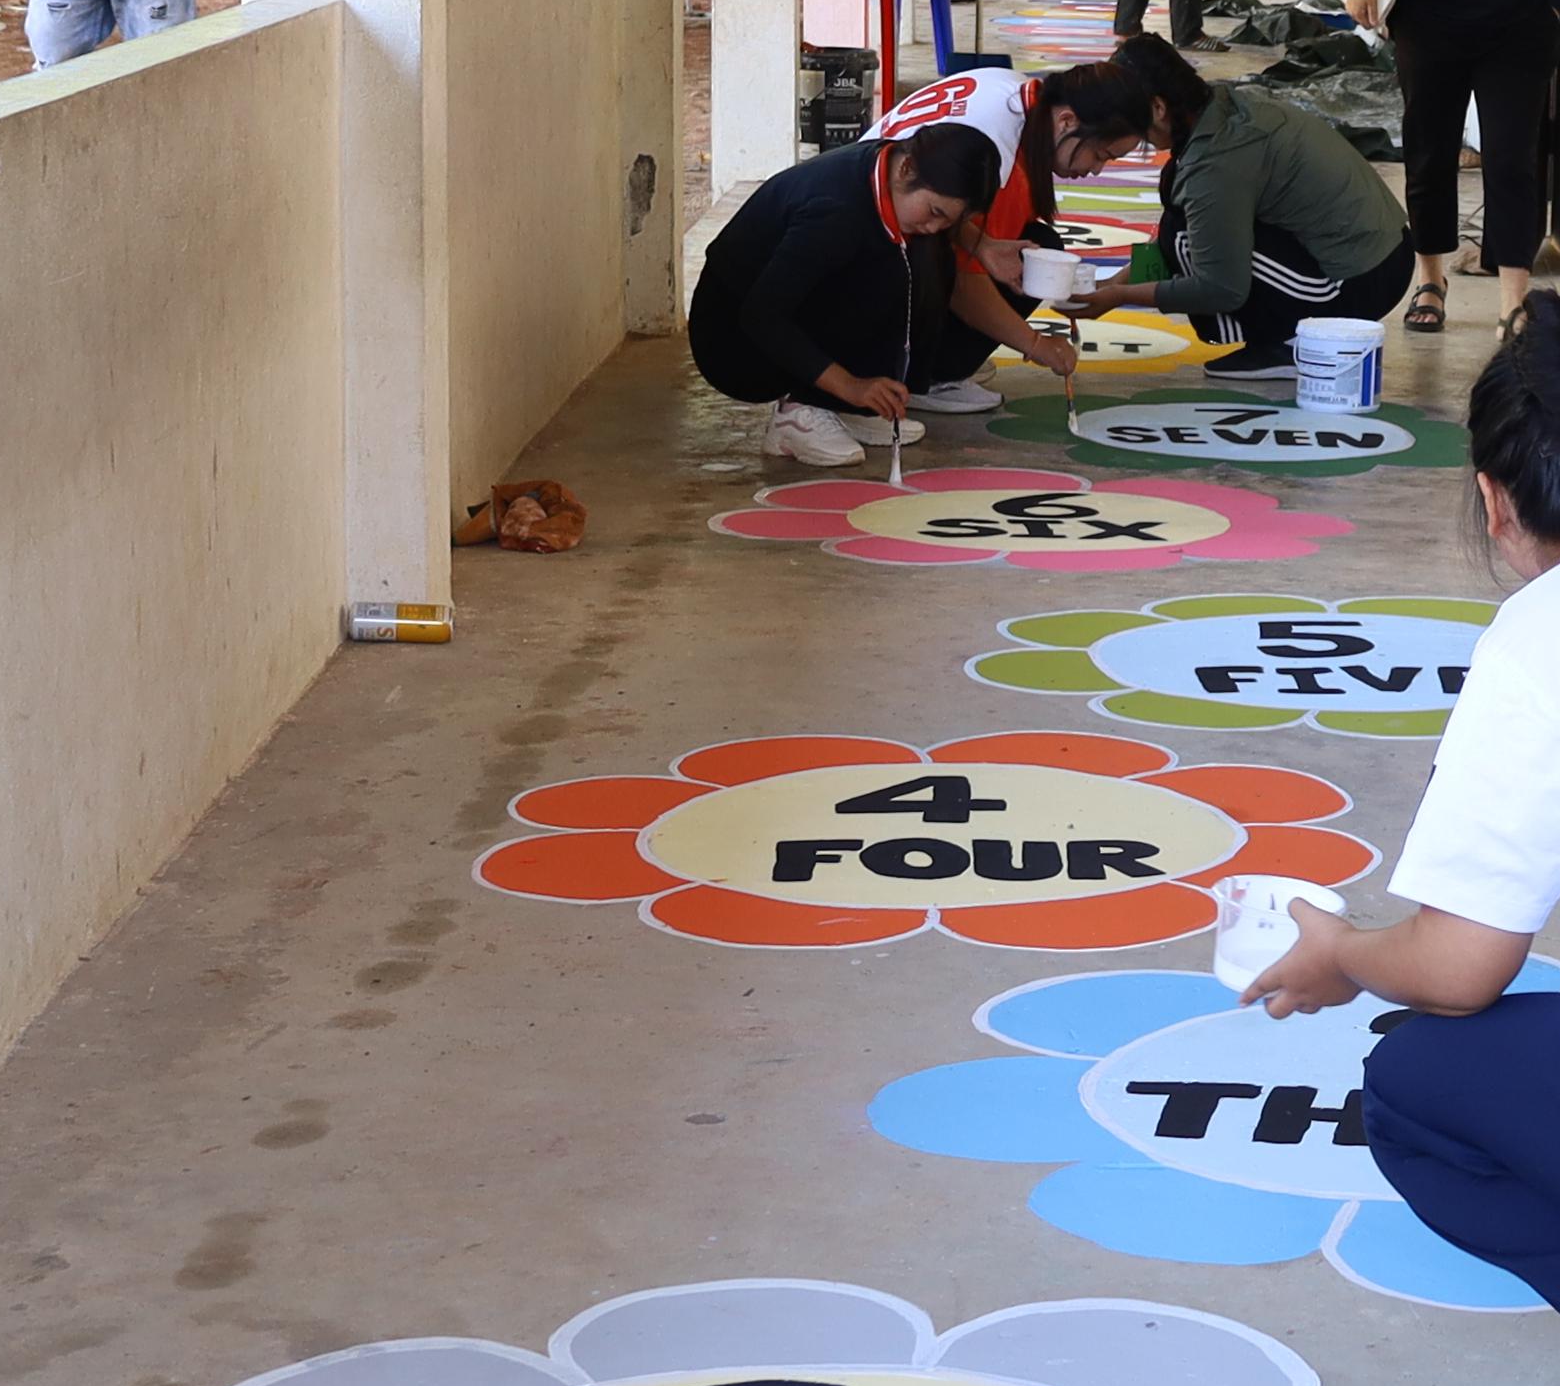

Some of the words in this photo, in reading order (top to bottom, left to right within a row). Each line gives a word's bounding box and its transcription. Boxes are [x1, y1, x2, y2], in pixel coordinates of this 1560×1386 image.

[1195, 409, 1279, 425] 7
[1107, 427, 1385, 449] SEVEN
[991, 493, 1100, 519] 6
[918, 518, 1167, 541] SIX
[1258, 621, 1374, 658] 5
[835, 776, 1007, 824] 4
[772, 837, 1166, 882] FOUR
